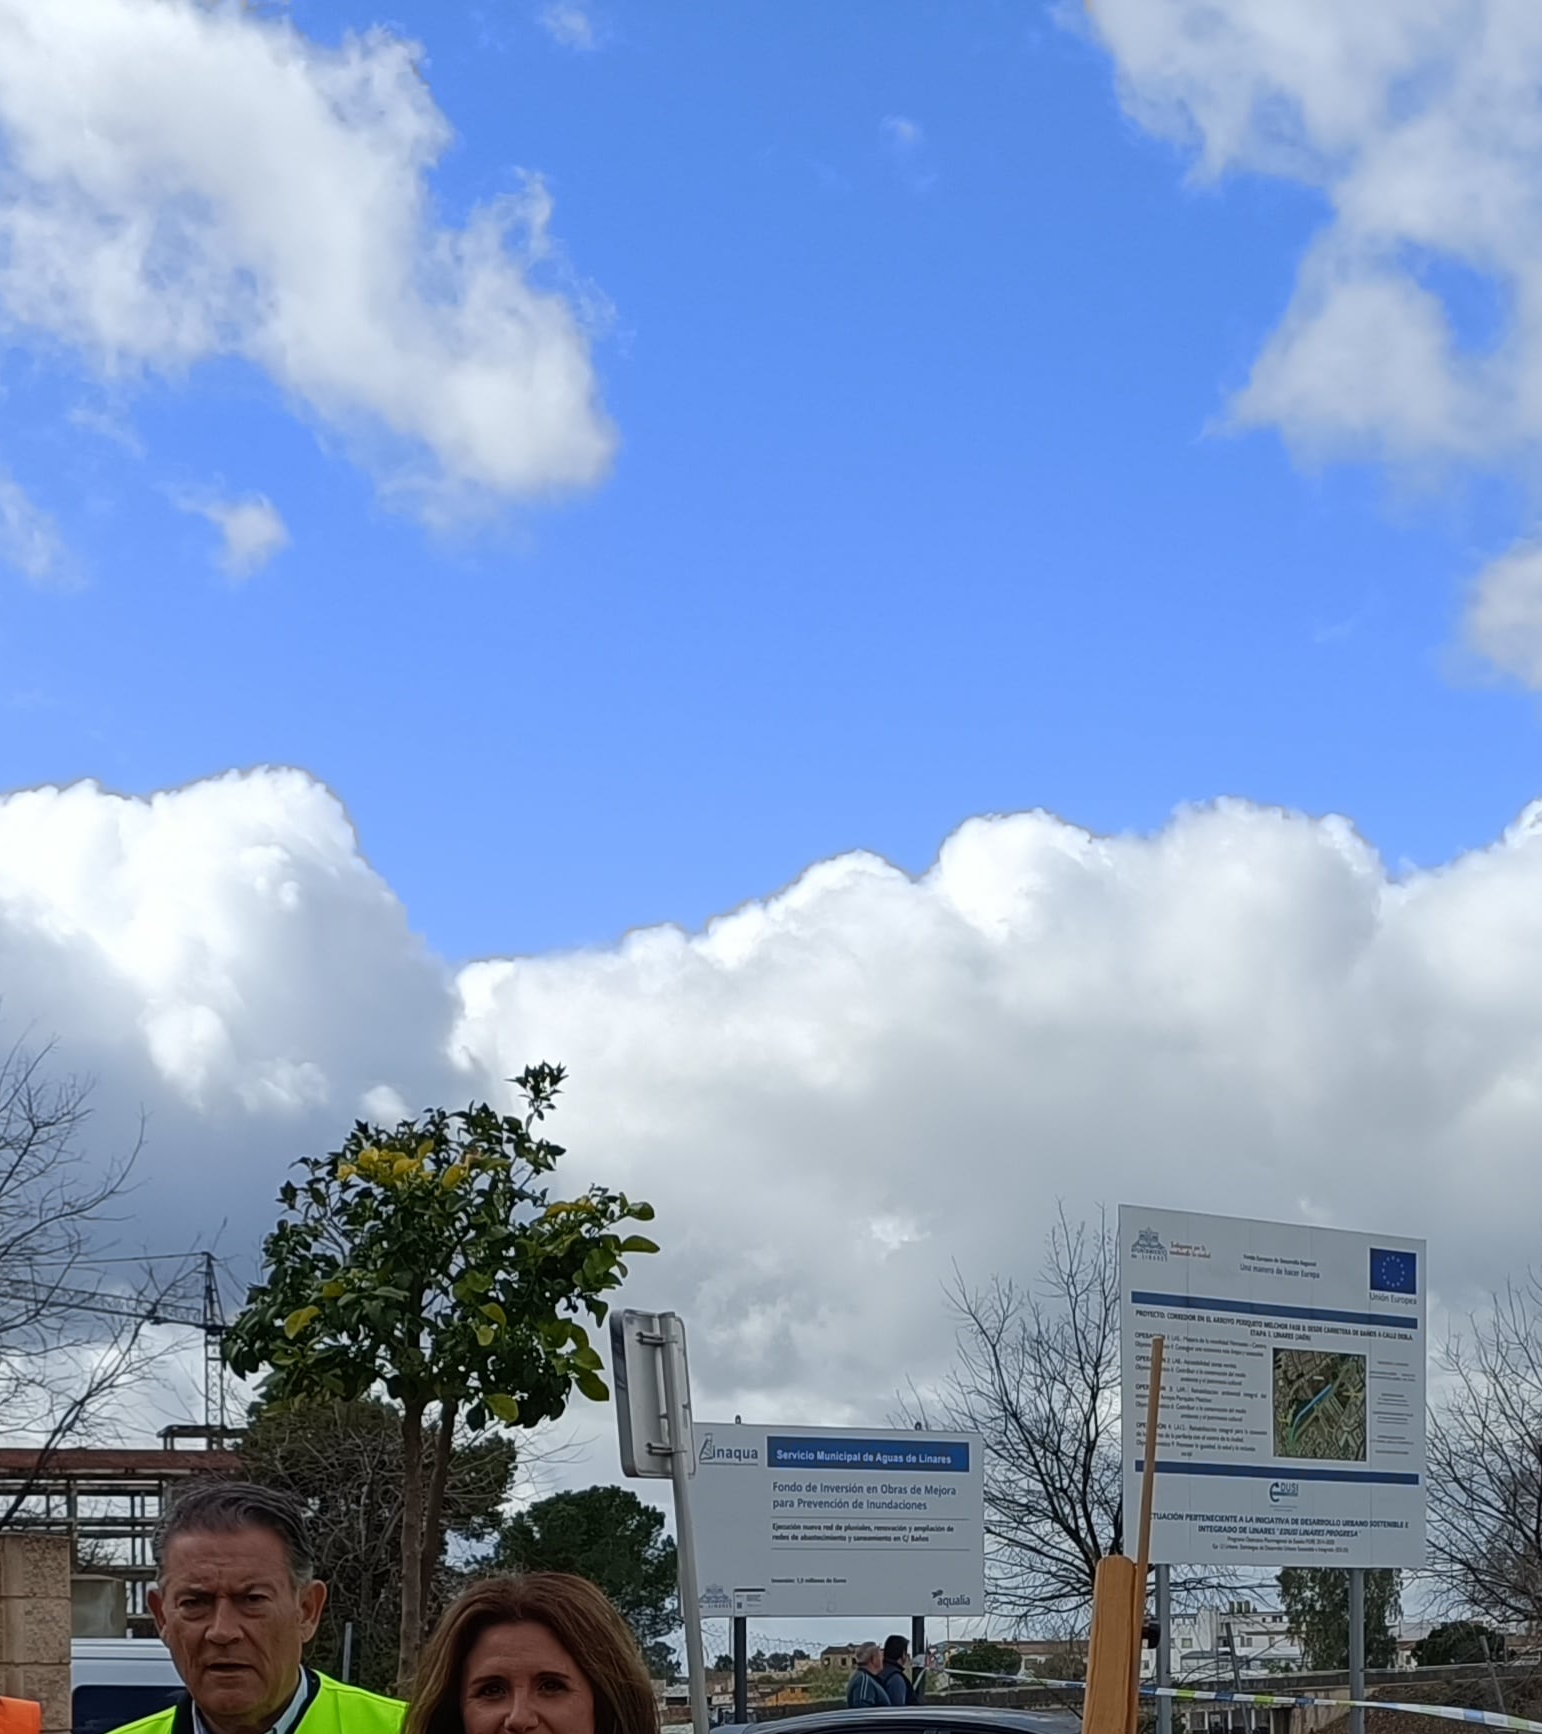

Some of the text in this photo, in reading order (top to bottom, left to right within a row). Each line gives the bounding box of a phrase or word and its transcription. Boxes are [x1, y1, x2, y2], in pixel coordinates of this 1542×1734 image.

[1370, 1291, 1417, 1305] Unión Europea
[776, 1449, 952, 1466] Servicio Municipal de Aguas de Linares
[772, 1481, 957, 1499] Fondo de Inversión en Obras de Mejora
[772, 1497, 928, 1512] para Prevención de Inundaciones
[823, 1523, 834, 1531] red
[835, 1523, 843, 1531] de
[1198, 1525, 1237, 1533] INTEGRADO
[1249, 1526, 1275, 1535] LINARES
[937, 1594, 971, 1608] aqualia
